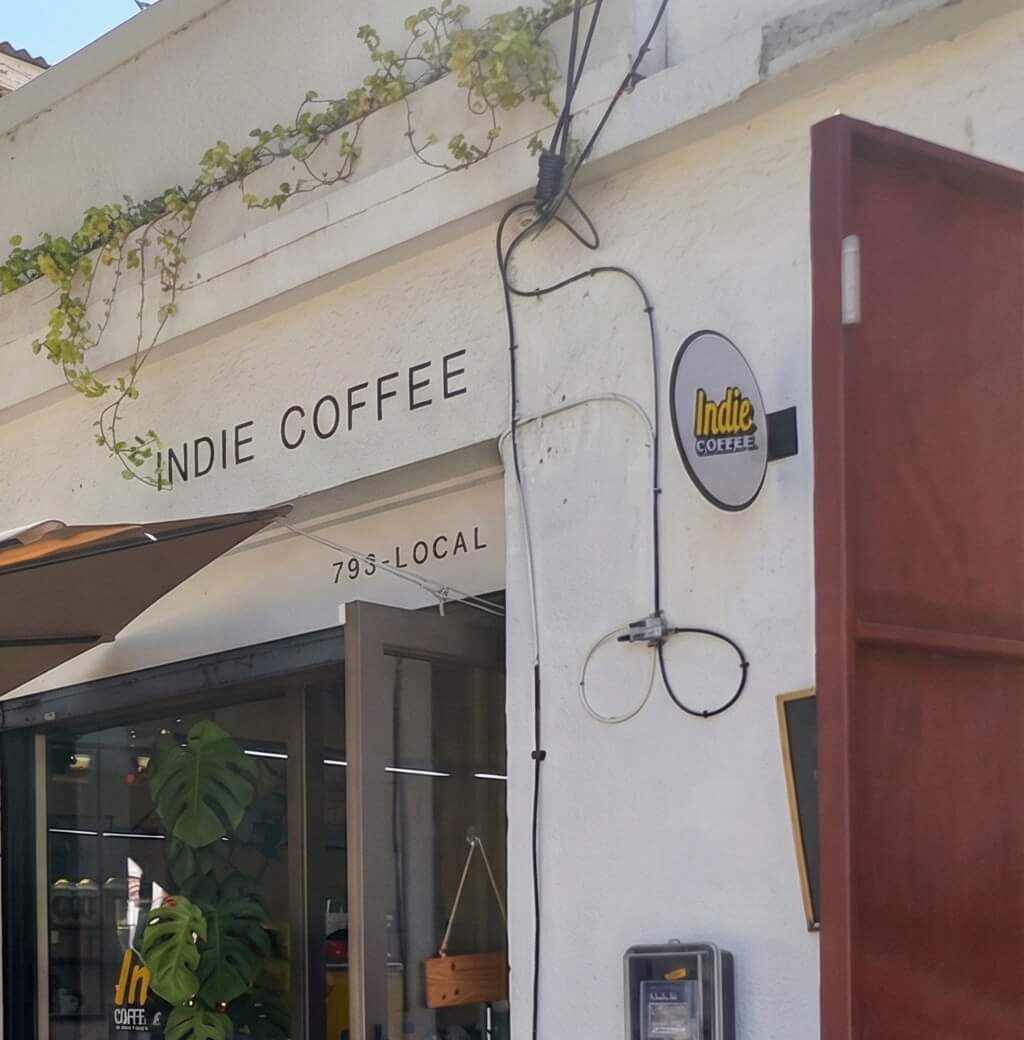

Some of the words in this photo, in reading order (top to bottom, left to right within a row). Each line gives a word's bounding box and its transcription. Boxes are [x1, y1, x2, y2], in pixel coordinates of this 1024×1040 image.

[156, 420, 255, 491] INDIE
[279, 348, 468, 450] COFFEE
[694, 387, 756, 438] Indie
[695, 436, 757, 455] COFFEE
